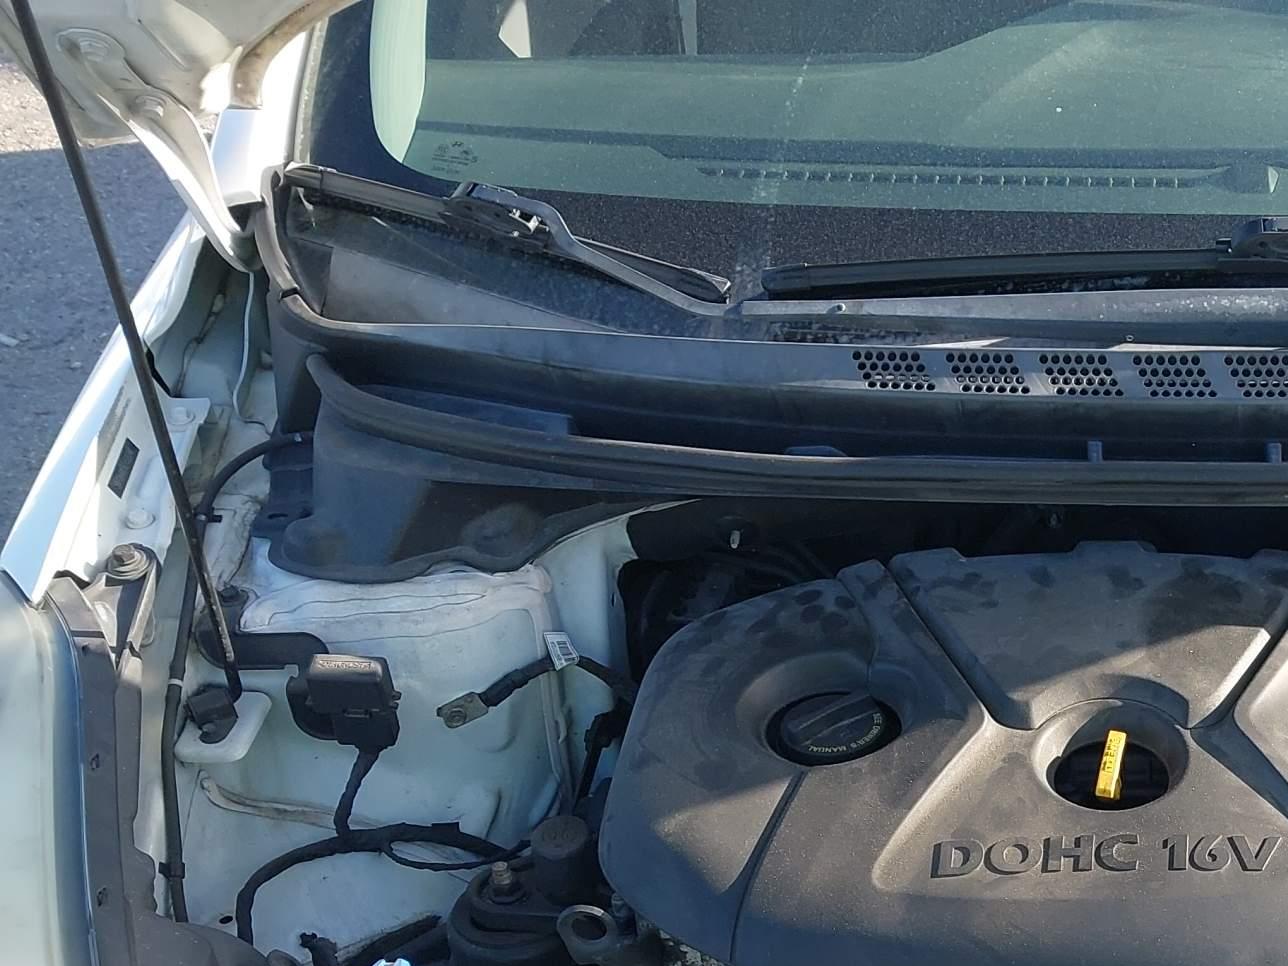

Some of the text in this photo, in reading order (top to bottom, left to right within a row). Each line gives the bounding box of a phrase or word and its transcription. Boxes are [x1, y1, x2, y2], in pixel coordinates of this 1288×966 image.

[808, 745, 847, 753] MANUAL
[930, 833, 1282, 879] DOHC 16V
